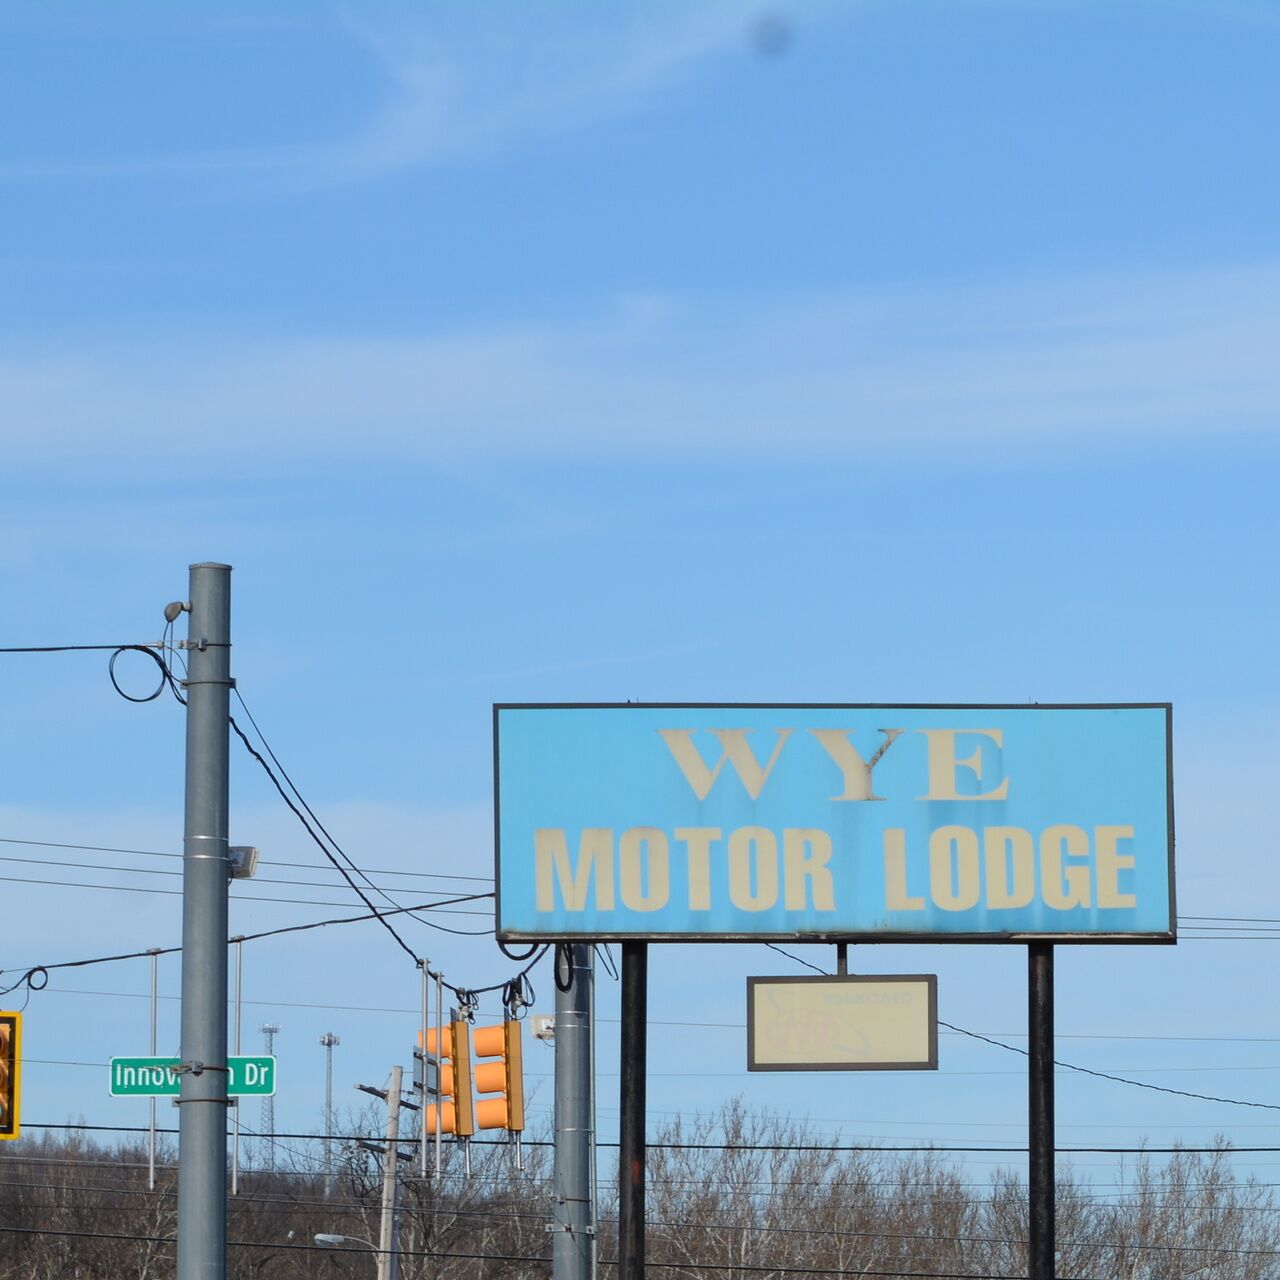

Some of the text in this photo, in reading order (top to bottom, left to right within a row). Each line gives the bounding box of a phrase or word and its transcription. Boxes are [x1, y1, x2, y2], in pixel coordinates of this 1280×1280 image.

[655, 728, 1010, 802] WYE
[534, 823, 1137, 912] MOTOR LODGE
[115, 1063, 269, 1086] Innovn Dr
